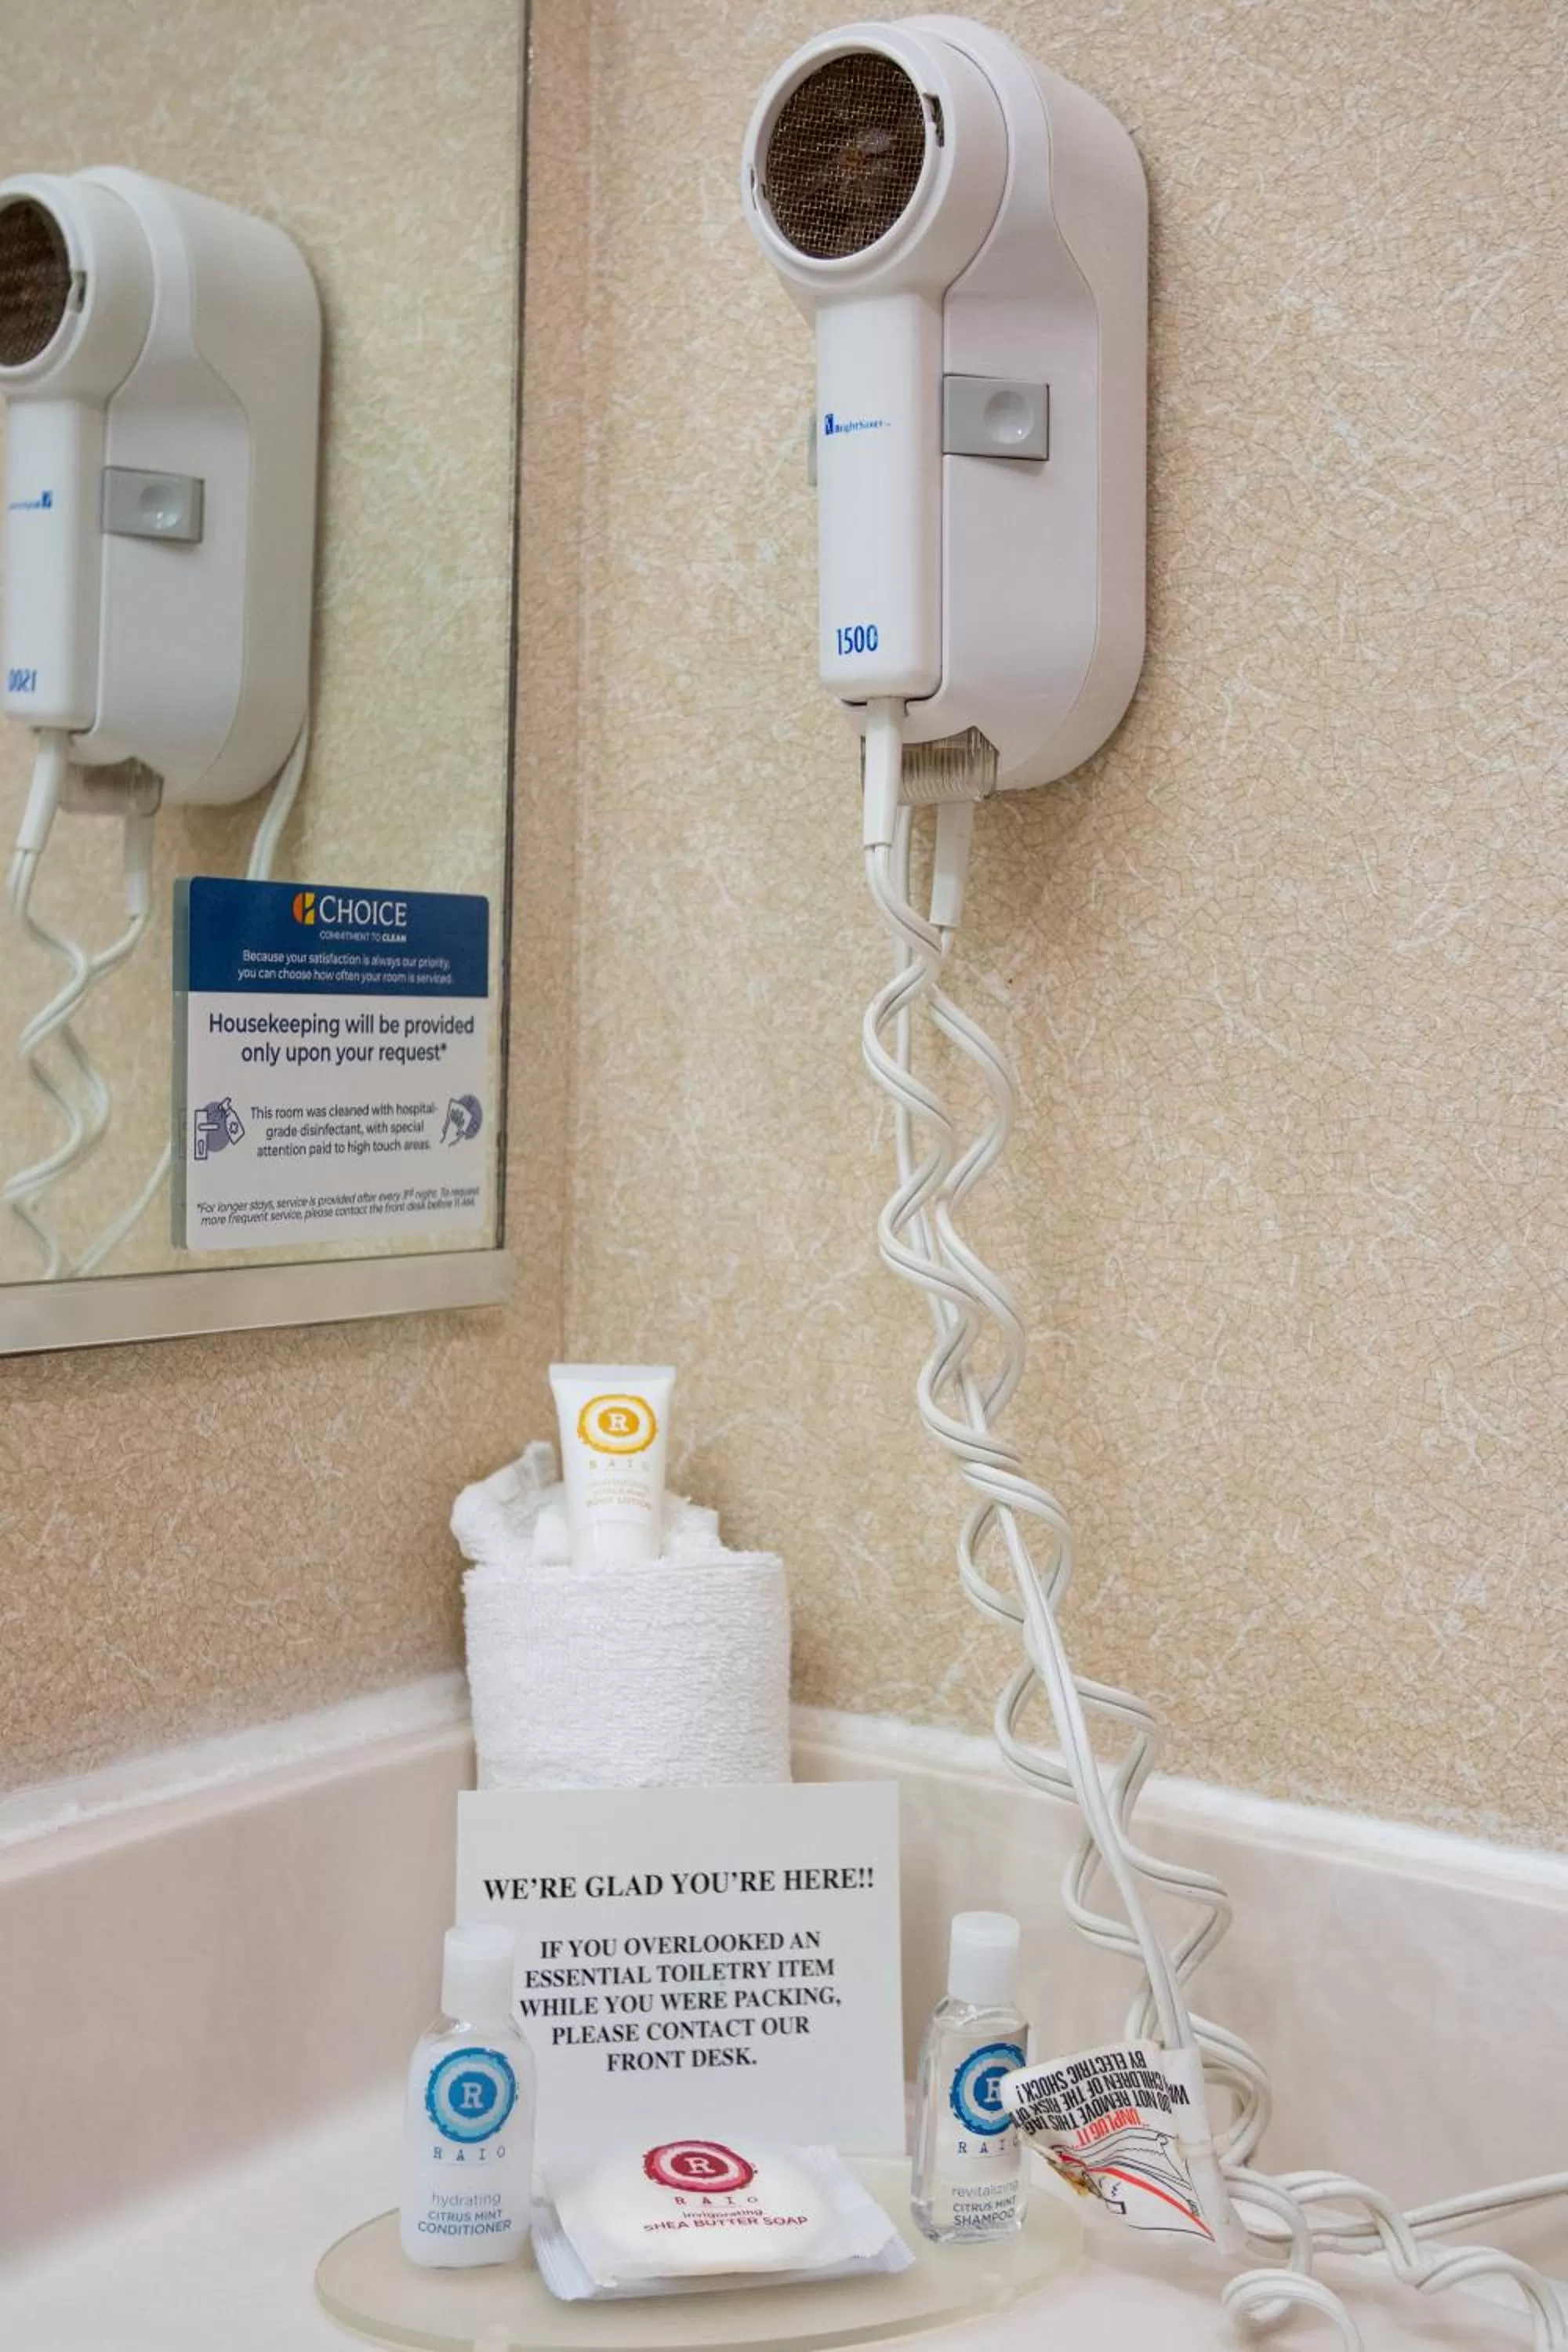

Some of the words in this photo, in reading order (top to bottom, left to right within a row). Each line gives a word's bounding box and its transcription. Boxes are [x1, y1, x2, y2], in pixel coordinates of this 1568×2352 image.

[837, 625, 878, 655] 1500
[319, 895, 407, 927] CHOICE
[382, 933, 407, 942] CLEAN
[242, 949, 285, 963] Because
[285, 953, 307, 965] your
[309, 953, 361, 965] satisfaction
[362, 953, 370, 966] is
[371, 954, 401, 969] always
[402, 958, 416, 967] our
[238, 968, 256, 982] you
[258, 969, 276, 979] can
[278, 967, 312, 980] choose
[314, 969, 334, 980] how
[336, 969, 360, 982] often
[361, 972, 380, 985] your
[382, 972, 406, 984] room
[209, 1013, 339, 1037] Housekeeping
[345, 1014, 373, 1033] will
[379, 1015, 399, 1034] be
[404, 1016, 474, 1037] provided
[241, 1042, 280, 1065] only
[286, 1047, 330, 1065] upon
[335, 1046, 373, 1065] your
[251, 1105, 273, 1120] This
[275, 1108, 303, 1119] room
[307, 1107, 327, 1117] was
[328, 1103, 368, 1117] cleaned
[371, 1103, 394, 1116] with
[266, 1123, 298, 1140] grade
[300, 1120, 364, 1137] disinfectant,
[365, 1120, 388, 1133] with
[390, 1120, 424, 1135] special
[256, 1143, 307, 1157] attention
[309, 1142, 331, 1158] paid
[333, 1144, 345, 1155] to
[347, 1141, 371, 1156] high
[372, 1139, 401, 1152] touch
[217, 1202, 249, 1214] longer
[276, 1196, 308, 1208] service
[318, 1192, 356, 1207] provided
[357, 1191, 377, 1203] after
[201, 1216, 227, 1226] more
[228, 1211, 267, 1226] frequent
[304, 1207, 333, 1222] please
[335, 1204, 367, 1217] contact
[608, 1414, 630, 1432] R
[484, 1878, 576, 1901] WE'RE
[585, 1874, 663, 1897] GLAD
[671, 1870, 775, 1894] YOU'RE
[783, 1867, 874, 1891] HERE!!
[540, 1940, 564, 1960] IF
[568, 1938, 617, 1958] YOU
[624, 1933, 784, 1956] OVERLOOKED
[789, 1931, 821, 1950] AN
[525, 1965, 652, 1989] ESSENTIAL
[657, 1961, 771, 1984] TOILETRY
[778, 1958, 835, 1979] ITEM
[520, 1997, 598, 2018] WHILE
[605, 1994, 654, 2014] YOU
[660, 1991, 728, 2012] WERE
[735, 1987, 842, 2008] PACKING,
[552, 2024, 639, 2045] PLEASE
[647, 2020, 756, 2042] CONTACT
[761, 2016, 810, 2036] OUR
[607, 2051, 685, 2072] FRONT
[691, 2047, 757, 2068] DESK.
[1066, 2053, 1127, 2085] ELECTRIC
[1127, 2050, 1147, 2070] BY
[1083, 2077, 1104, 2097] OF
[1103, 2071, 1164, 2092] CHILDREN
[459, 2082, 484, 2108] R
[1029, 2094, 1060, 2116] RISK
[1058, 2085, 1085, 2106] THE
[1131, 2089, 1158, 2110] NOT
[1079, 2090, 1131, 2123] REMOVE
[1022, 2116, 1049, 2136] TAG
[1048, 2111, 1080, 2131] THIS
[433, 2146, 506, 2161] RAIO
[683, 2157, 716, 2174] R
[952, 2180, 1019, 2198] revitalizing
[432, 2191, 501, 2209] hydrating
[674, 2196, 758, 2205] RAIO
[953, 2202, 992, 2214] CITRUS
[995, 2195, 1017, 2209] MINT
[428, 2210, 470, 2222] CITRUS
[474, 2209, 502, 2221] MINT
[644, 2220, 689, 2231] SHEA
[693, 2216, 758, 2227] BUTTER
[763, 2216, 808, 2226] SOAP
[953, 2209, 1015, 2227] SHAMPOO
[418, 2220, 512, 2235] CONDITIONER
